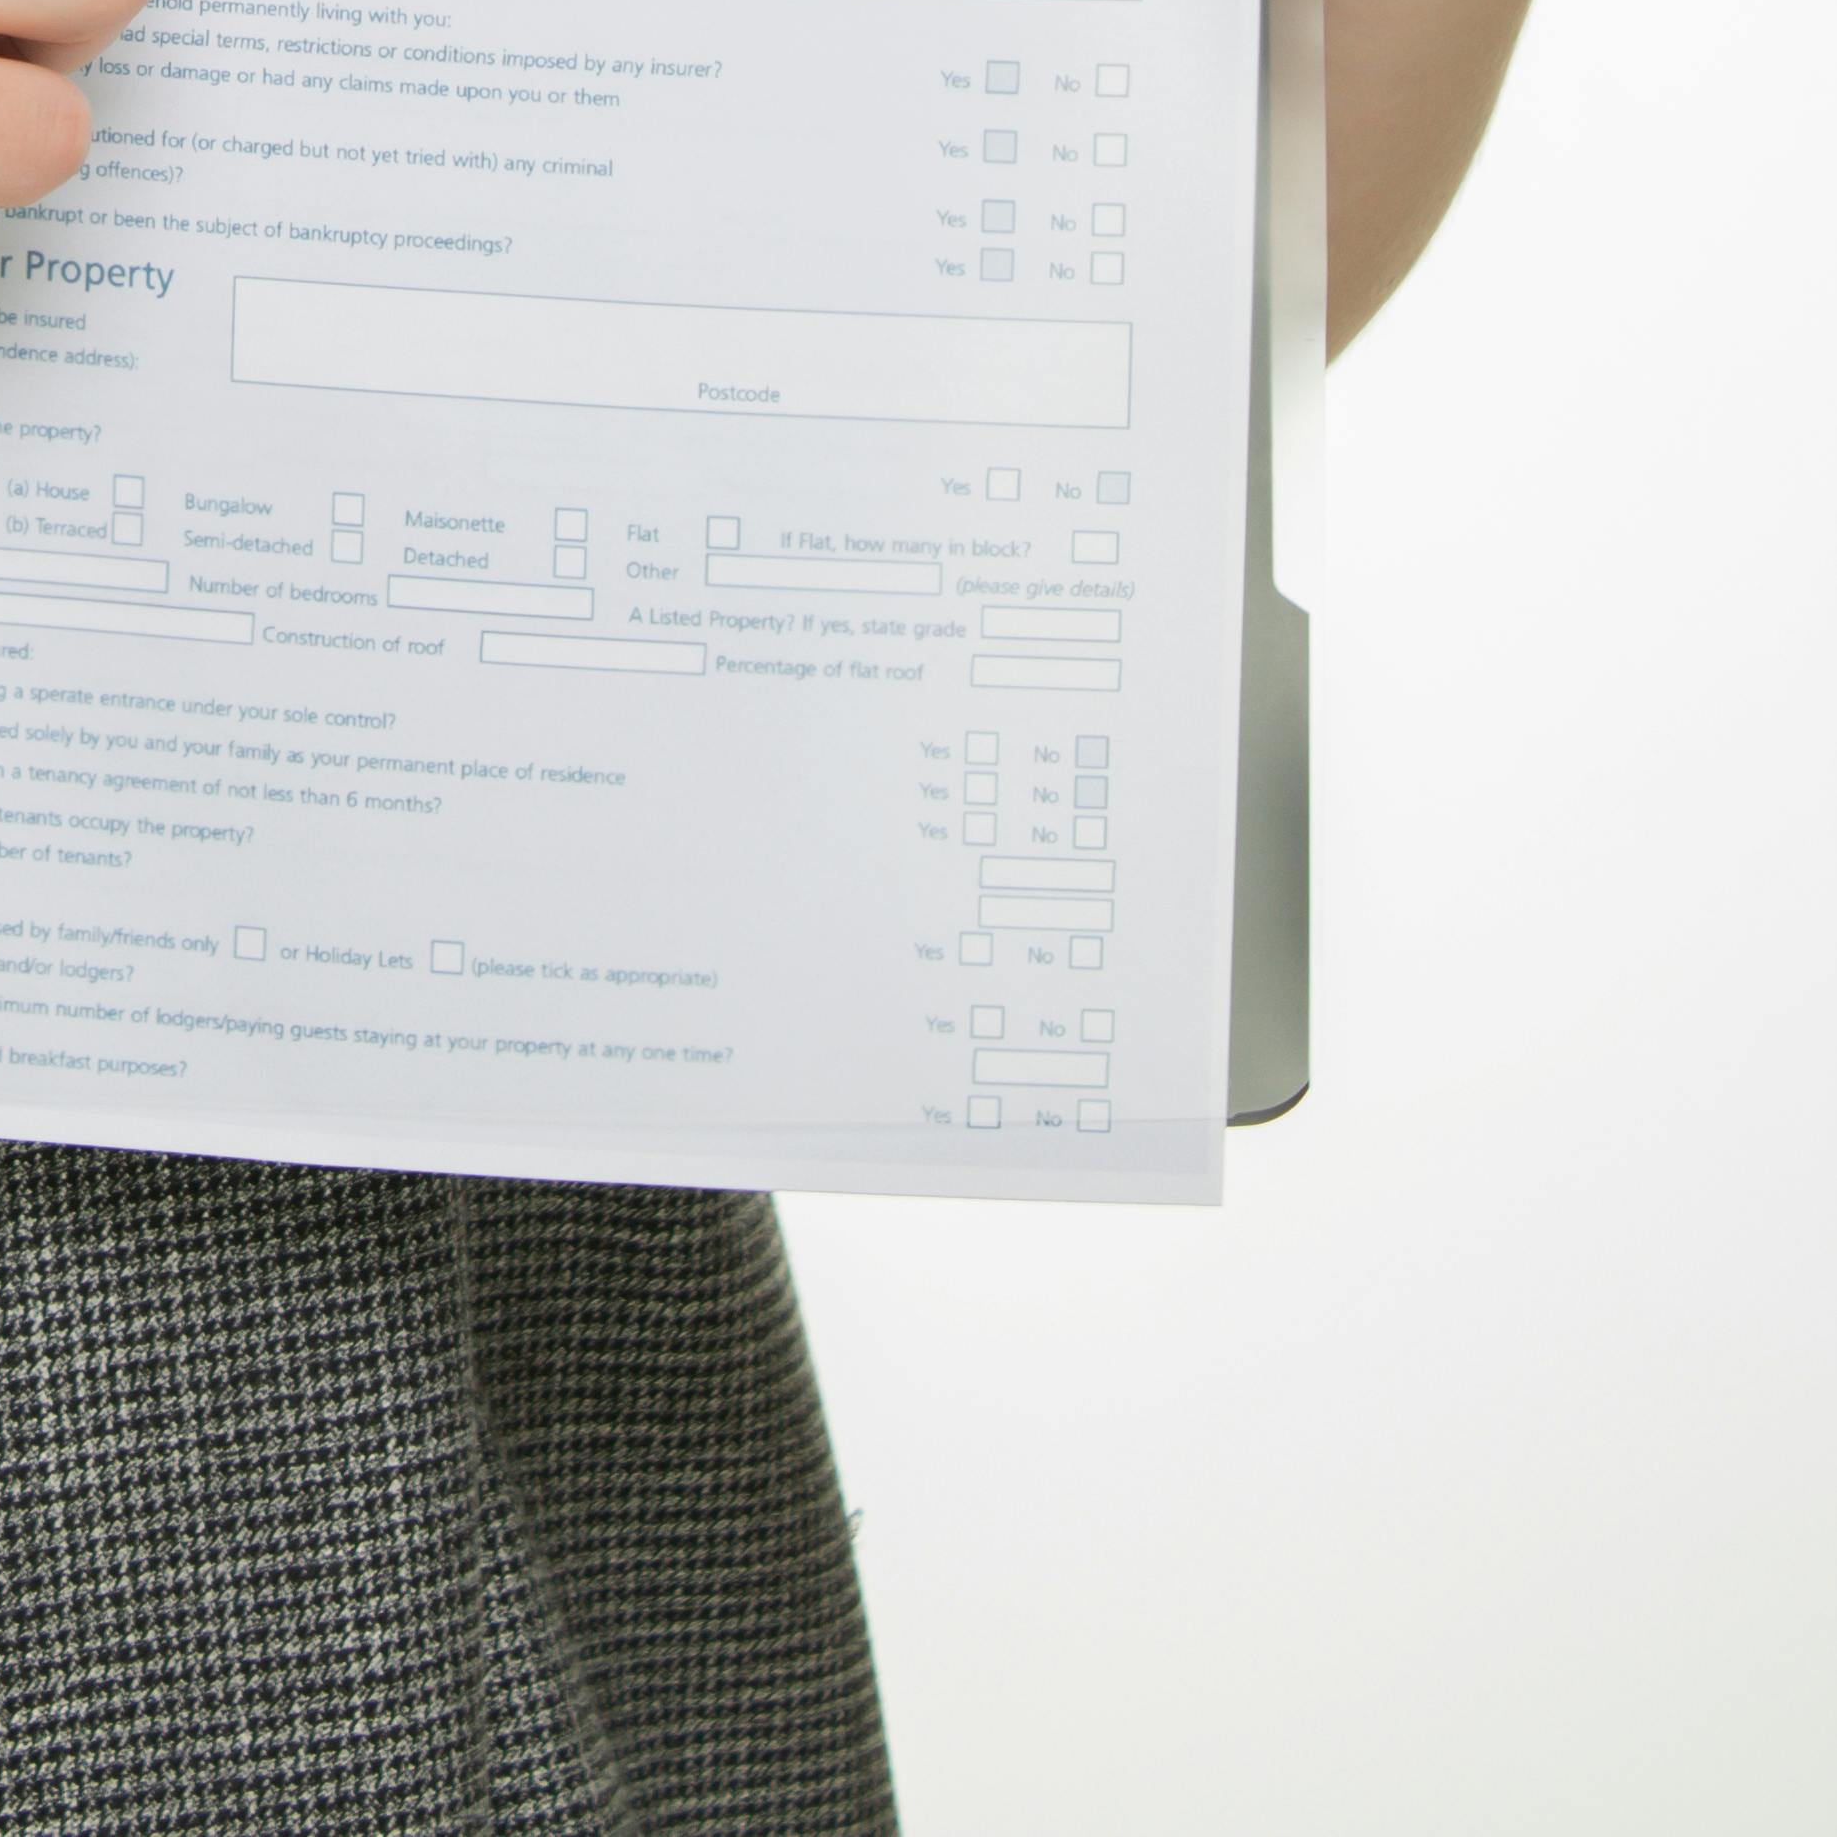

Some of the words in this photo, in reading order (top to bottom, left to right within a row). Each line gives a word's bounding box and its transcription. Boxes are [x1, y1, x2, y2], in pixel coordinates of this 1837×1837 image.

[199, 0, 311, 23] permanently
[316, 2, 363, 27] living
[367, 7, 408, 25] with
[413, 13, 451, 31] you:
[151, 28, 210, 49] special
[216, 32, 270, 53] terms,
[277, 37, 372, 58] restrictions
[377, 45, 398, 59] or
[403, 44, 496, 66] conditions
[501, 53, 578, 71] imposed
[583, 53, 607, 77] by
[611, 60, 645, 79] any
[650, 57, 723, 79] insurer?
[99, 56, 131, 76] loss
[135, 64, 155, 77] or
[160, 61, 232, 87] damage
[236, 71, 256, 84] or
[262, 67, 295, 87] had
[301, 75, 334, 94] any
[338, 73, 394, 94] claims
[399, 79, 450, 97] made
[455, 85, 503, 103] upon
[508, 88, 542, 106] you
[547, 91, 567, 104] or
[573, 87, 620, 107] them
[940, 70, 972, 89] Yes
[1054, 74, 1082, 94] No
[161, 129, 187, 149] for
[191, 132, 217, 153] (or
[221, 135, 294, 160] charged
[299, 139, 330, 159] but
[336, 145, 366, 162] not
[371, 148, 399, 167] yet
[405, 148, 446, 167] tried
[451, 151, 499, 173] with)
[503, 158, 536, 177] any
[542, 159, 613, 177] criminal
[938, 139, 969, 159] Yes
[1052, 144, 1079, 163] No
[95, 160, 184, 185] offences)?
[935, 209, 968, 229] Yes
[1050, 213, 1077, 232] No
[89, 211, 108, 225] or
[113, 209, 156, 229] been
[162, 213, 190, 232] the
[195, 216, 258, 239] subject
[263, 220, 283, 239] of
[289, 221, 388, 250] bankruptcy
[393, 234, 513, 257] proceedings?
[26, 249, 175, 299] Property
[24, 313, 87, 331] insured
[63, 347, 139, 371] address):
[697, 381, 781, 404] Postcode
[19, 423, 102, 446] property?
[7, 477, 30, 498] (a)
[35, 481, 91, 502] House
[184, 492, 273, 518] Bungalow
[5, 514, 30, 536] (b)
[35, 517, 109, 541] Terraced
[404, 509, 506, 534] Maisonette
[627, 523, 660, 543] Flat
[183, 529, 314, 557] Semi-detached
[403, 546, 489, 570] Detached
[626, 560, 680, 581] Other
[189, 574, 260, 597] Number
[265, 581, 284, 599] of
[289, 582, 379, 607] bedrooms
[262, 625, 376, 651] Construction
[381, 635, 402, 653] of
[407, 638, 446, 656] roof
[68, 815, 131, 837] occupy
[136, 816, 166, 836] the
[171, 824, 255, 847] property?
[59, 959, 135, 985] lodgers?
[8, 1046, 92, 1071] breakfast
[96, 1058, 188, 1078] purposes?
